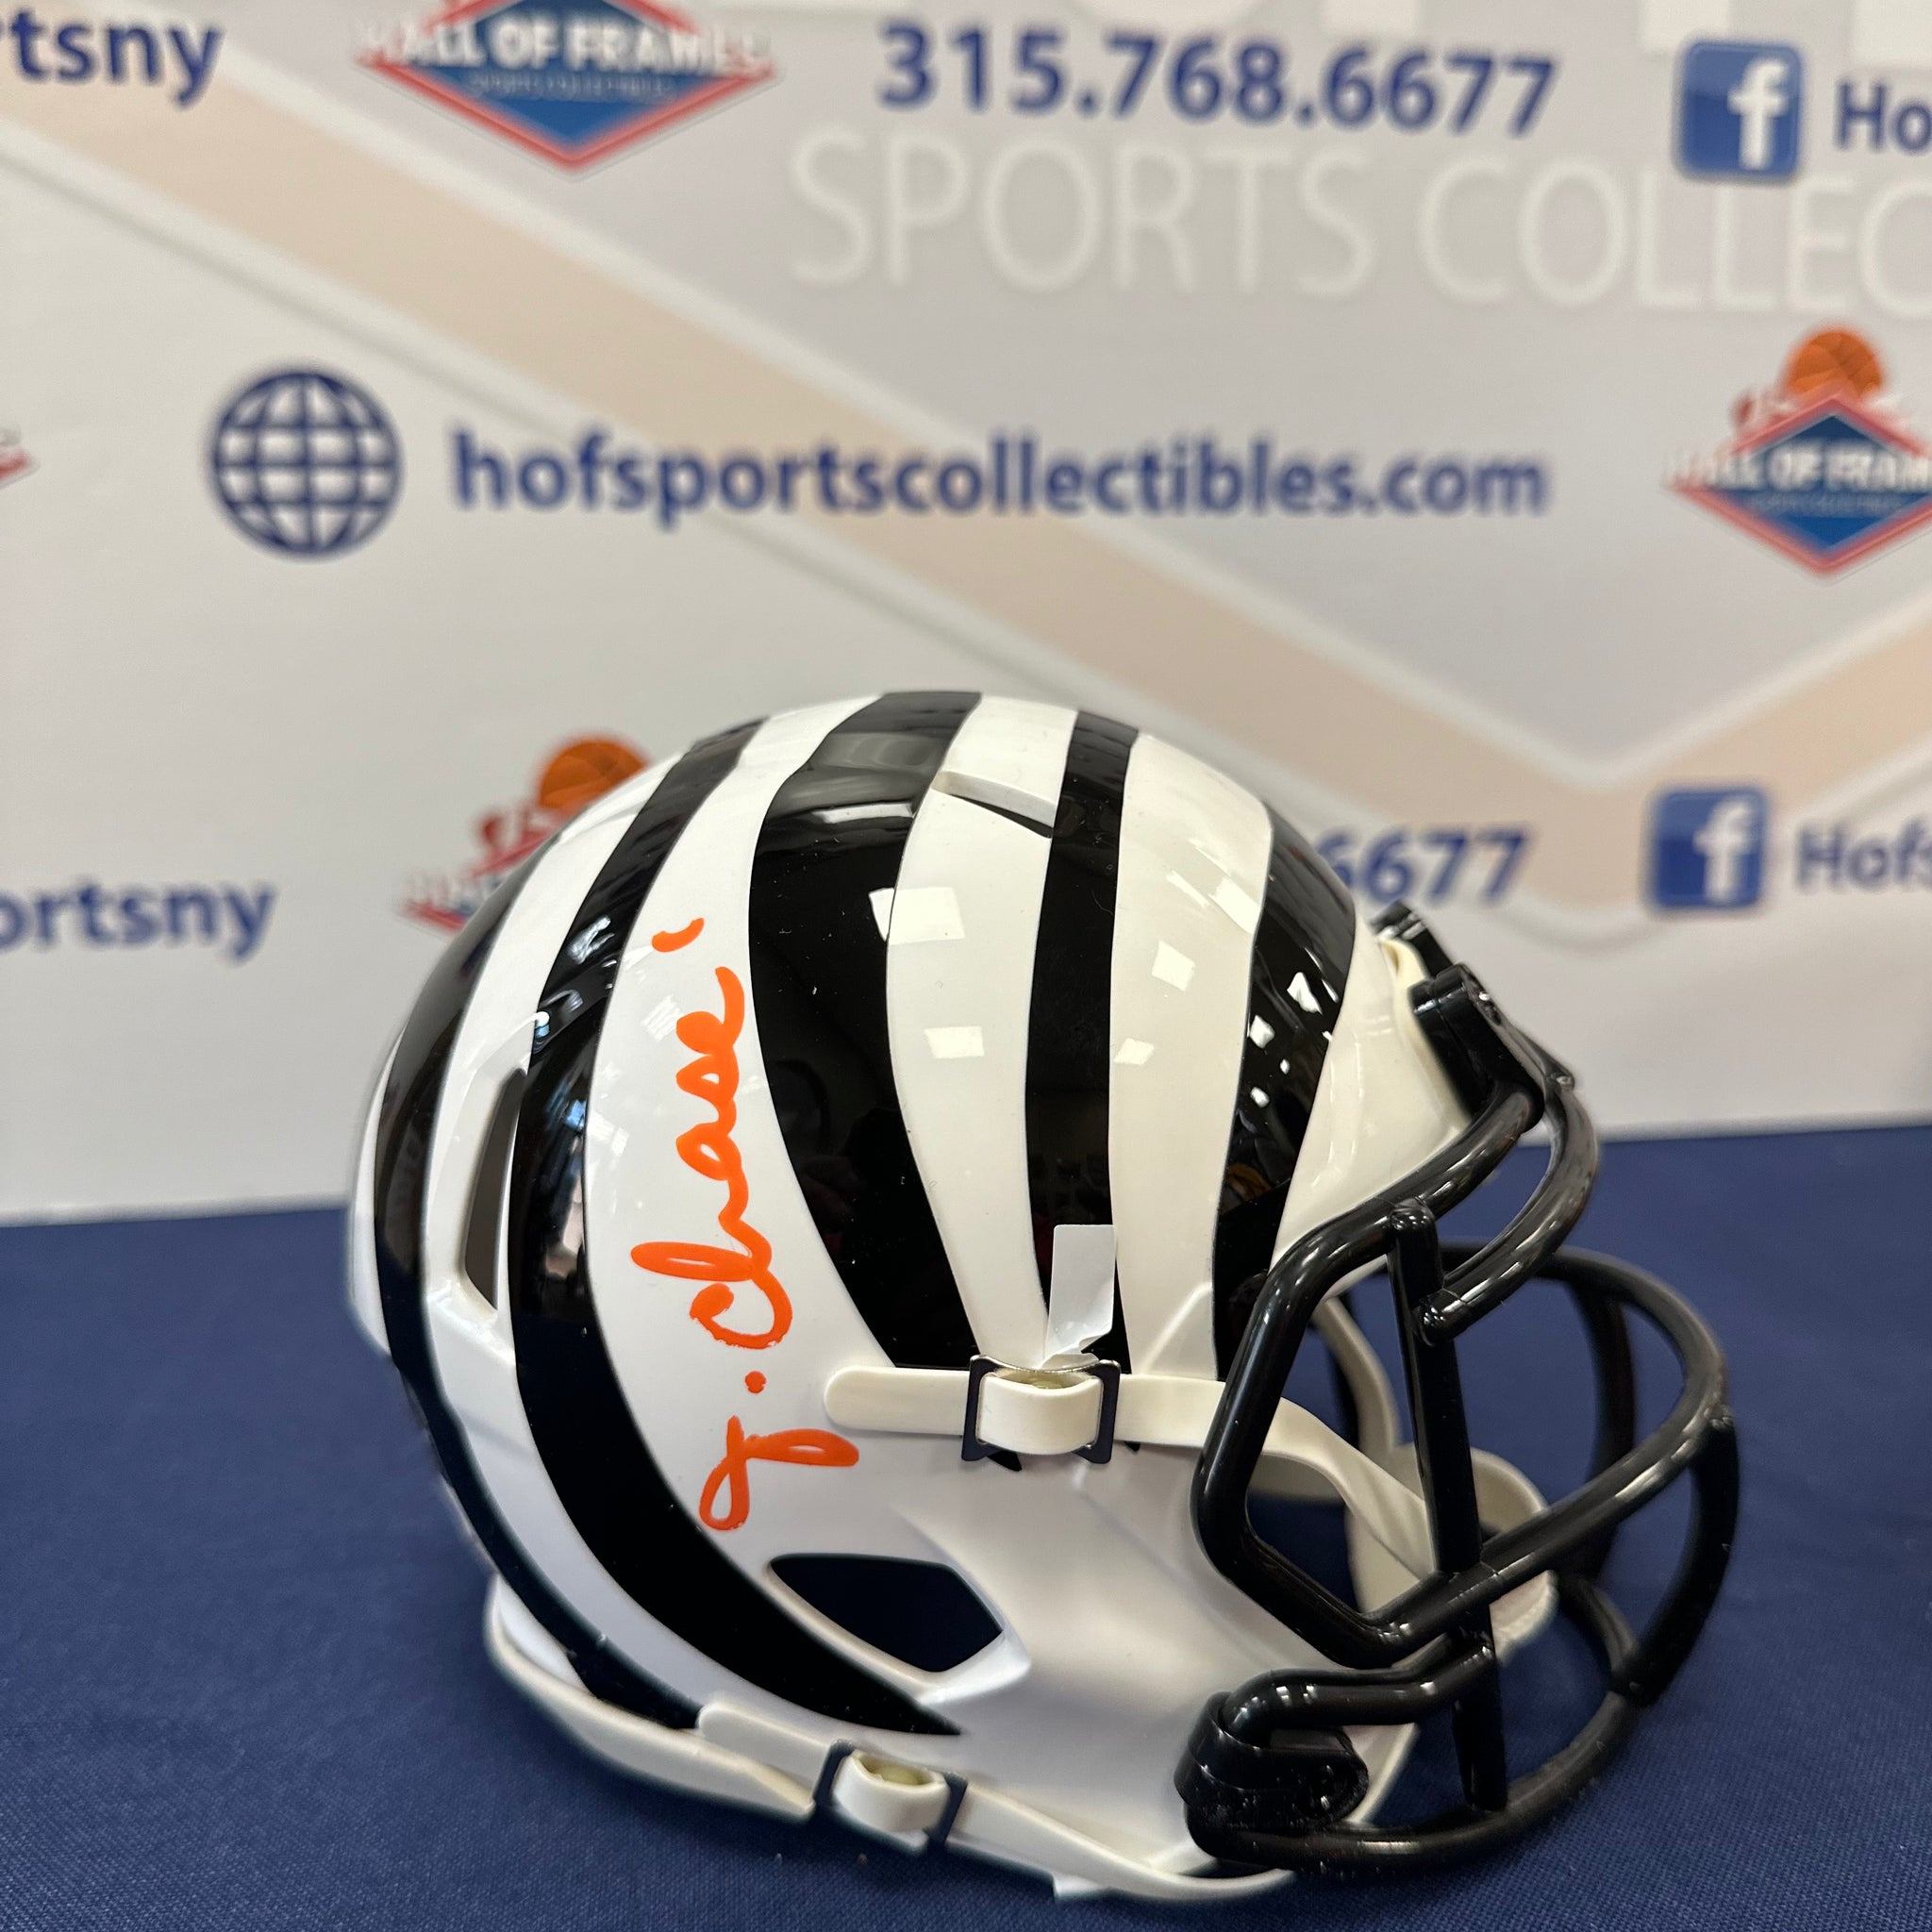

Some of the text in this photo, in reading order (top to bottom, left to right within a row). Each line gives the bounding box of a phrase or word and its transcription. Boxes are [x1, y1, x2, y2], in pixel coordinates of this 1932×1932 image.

[0, 11, 223, 108] tsny
[489, 14, 558, 69] OF
[879, 23, 1558, 134] 315.768.6677
[789, 125, 1377, 296] SPORTS
[449, 426, 1551, 531] hofsportscollectibles.com
